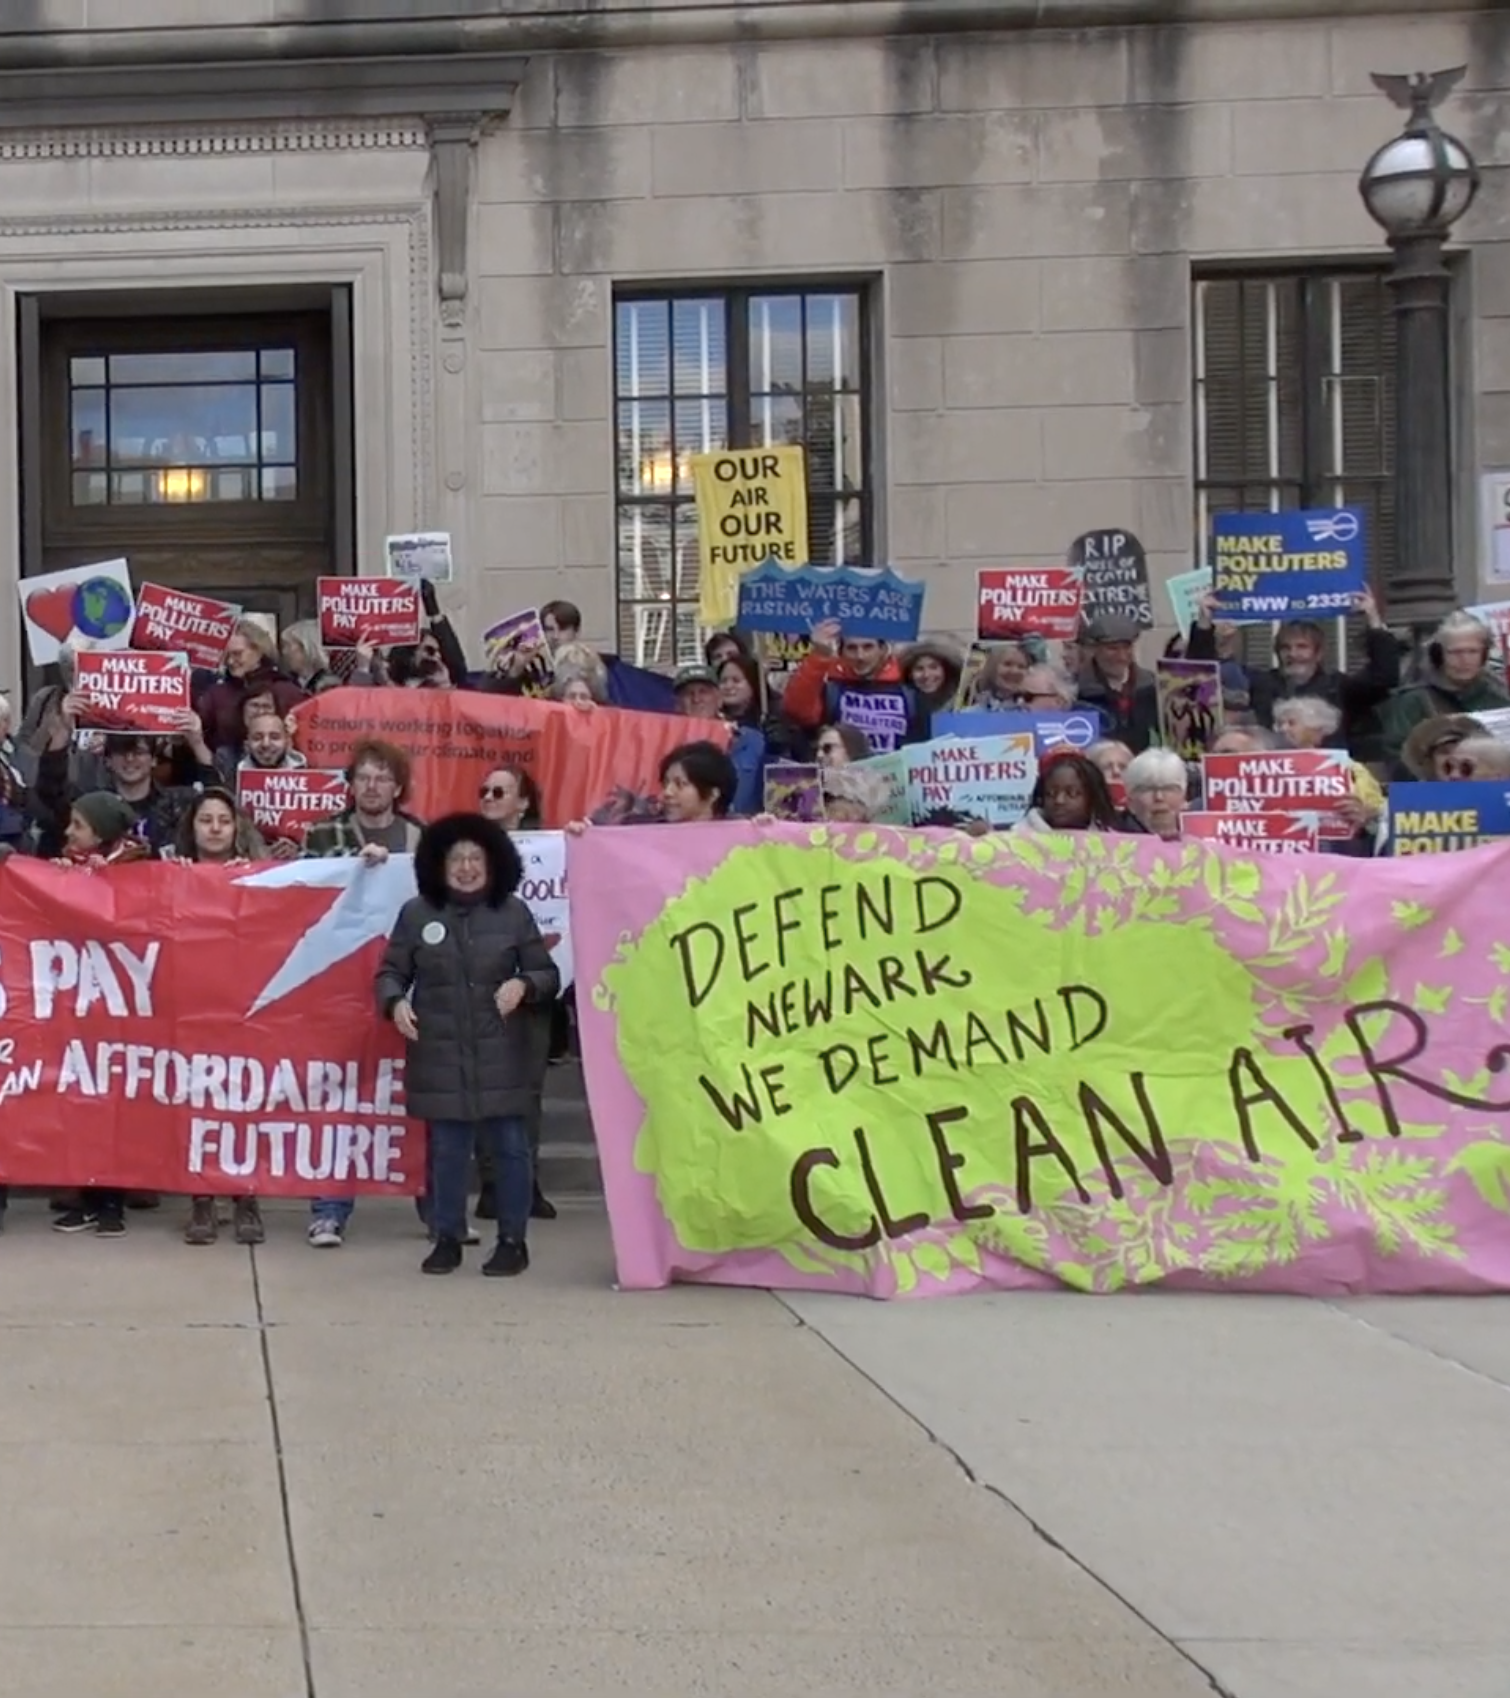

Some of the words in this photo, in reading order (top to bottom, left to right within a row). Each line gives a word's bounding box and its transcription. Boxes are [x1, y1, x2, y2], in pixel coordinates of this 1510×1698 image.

[714, 454, 781, 483] OUR
[730, 487, 769, 508] AIR
[720, 512, 783, 537] OUR
[710, 541, 795, 564] FUTURE
[1085, 534, 1125, 558] RIP
[1216, 534, 1283, 553] MAKE
[1216, 551, 1348, 573] POLLUTERS
[340, 583, 380, 598] MAKE
[1005, 574, 1049, 589] MAKE
[1216, 574, 1258, 591] PAY
[164, 596, 205, 617] MAKE
[321, 596, 415, 615] POLLUTERS
[749, 583, 787, 599] THE
[796, 584, 870, 602] WATERS
[876, 589, 914, 610] ARE
[980, 588, 1078, 607] POLLUTERS
[1242, 596, 1289, 612] FWW
[1291, 600, 1306, 610] TO
[1307, 592, 1354, 609] 2332
[138, 601, 232, 639] POLLUTERS
[333, 613, 358, 628] PAY
[742, 602, 813, 617] RISING
[838, 602, 867, 618] SO
[868, 606, 910, 622] ARE
[993, 606, 1026, 622] PAY
[146, 624, 176, 642] PAY
[102, 658, 147, 674] MAKE
[78, 673, 184, 696] POLLUTERS
[90, 692, 122, 710] PAY
[845, 694, 900, 712] MAKE
[309, 714, 375, 732] Seniors
[380, 718, 452, 739] working
[456, 721, 533, 741] together
[845, 713, 906, 732] POLLUTERS
[308, 739, 325, 752] to
[433, 745, 497, 762] climate
[501, 749, 535, 763] and
[932, 746, 979, 763] MAKE
[909, 761, 1027, 784] POLLUTERS
[1240, 758, 1296, 776] MAKE
[264, 776, 308, 791] MAKE
[922, 785, 953, 802] PAY
[1208, 776, 1346, 798] POLLUTERS
[241, 790, 347, 811] POLLUTERS
[1226, 798, 1265, 813] PAY
[254, 809, 283, 827] PAY
[1217, 819, 1269, 836] MAKE
[1394, 809, 1479, 835] MAKE
[1204, 837, 1310, 854] LUTERS
[669, 873, 964, 1008] DEFEND
[31, 939, 161, 1019] PAY
[745, 949, 973, 1047] NEWARK
[698, 1062, 792, 1132] WE
[817, 984, 1109, 1095] DEMAND
[57, 1039, 406, 1115] AFFORDABLE
[788, 1071, 1174, 1251] CLEAN
[1225, 999, 1510, 1163] AIR
[188, 1119, 406, 1183] FUTURE
